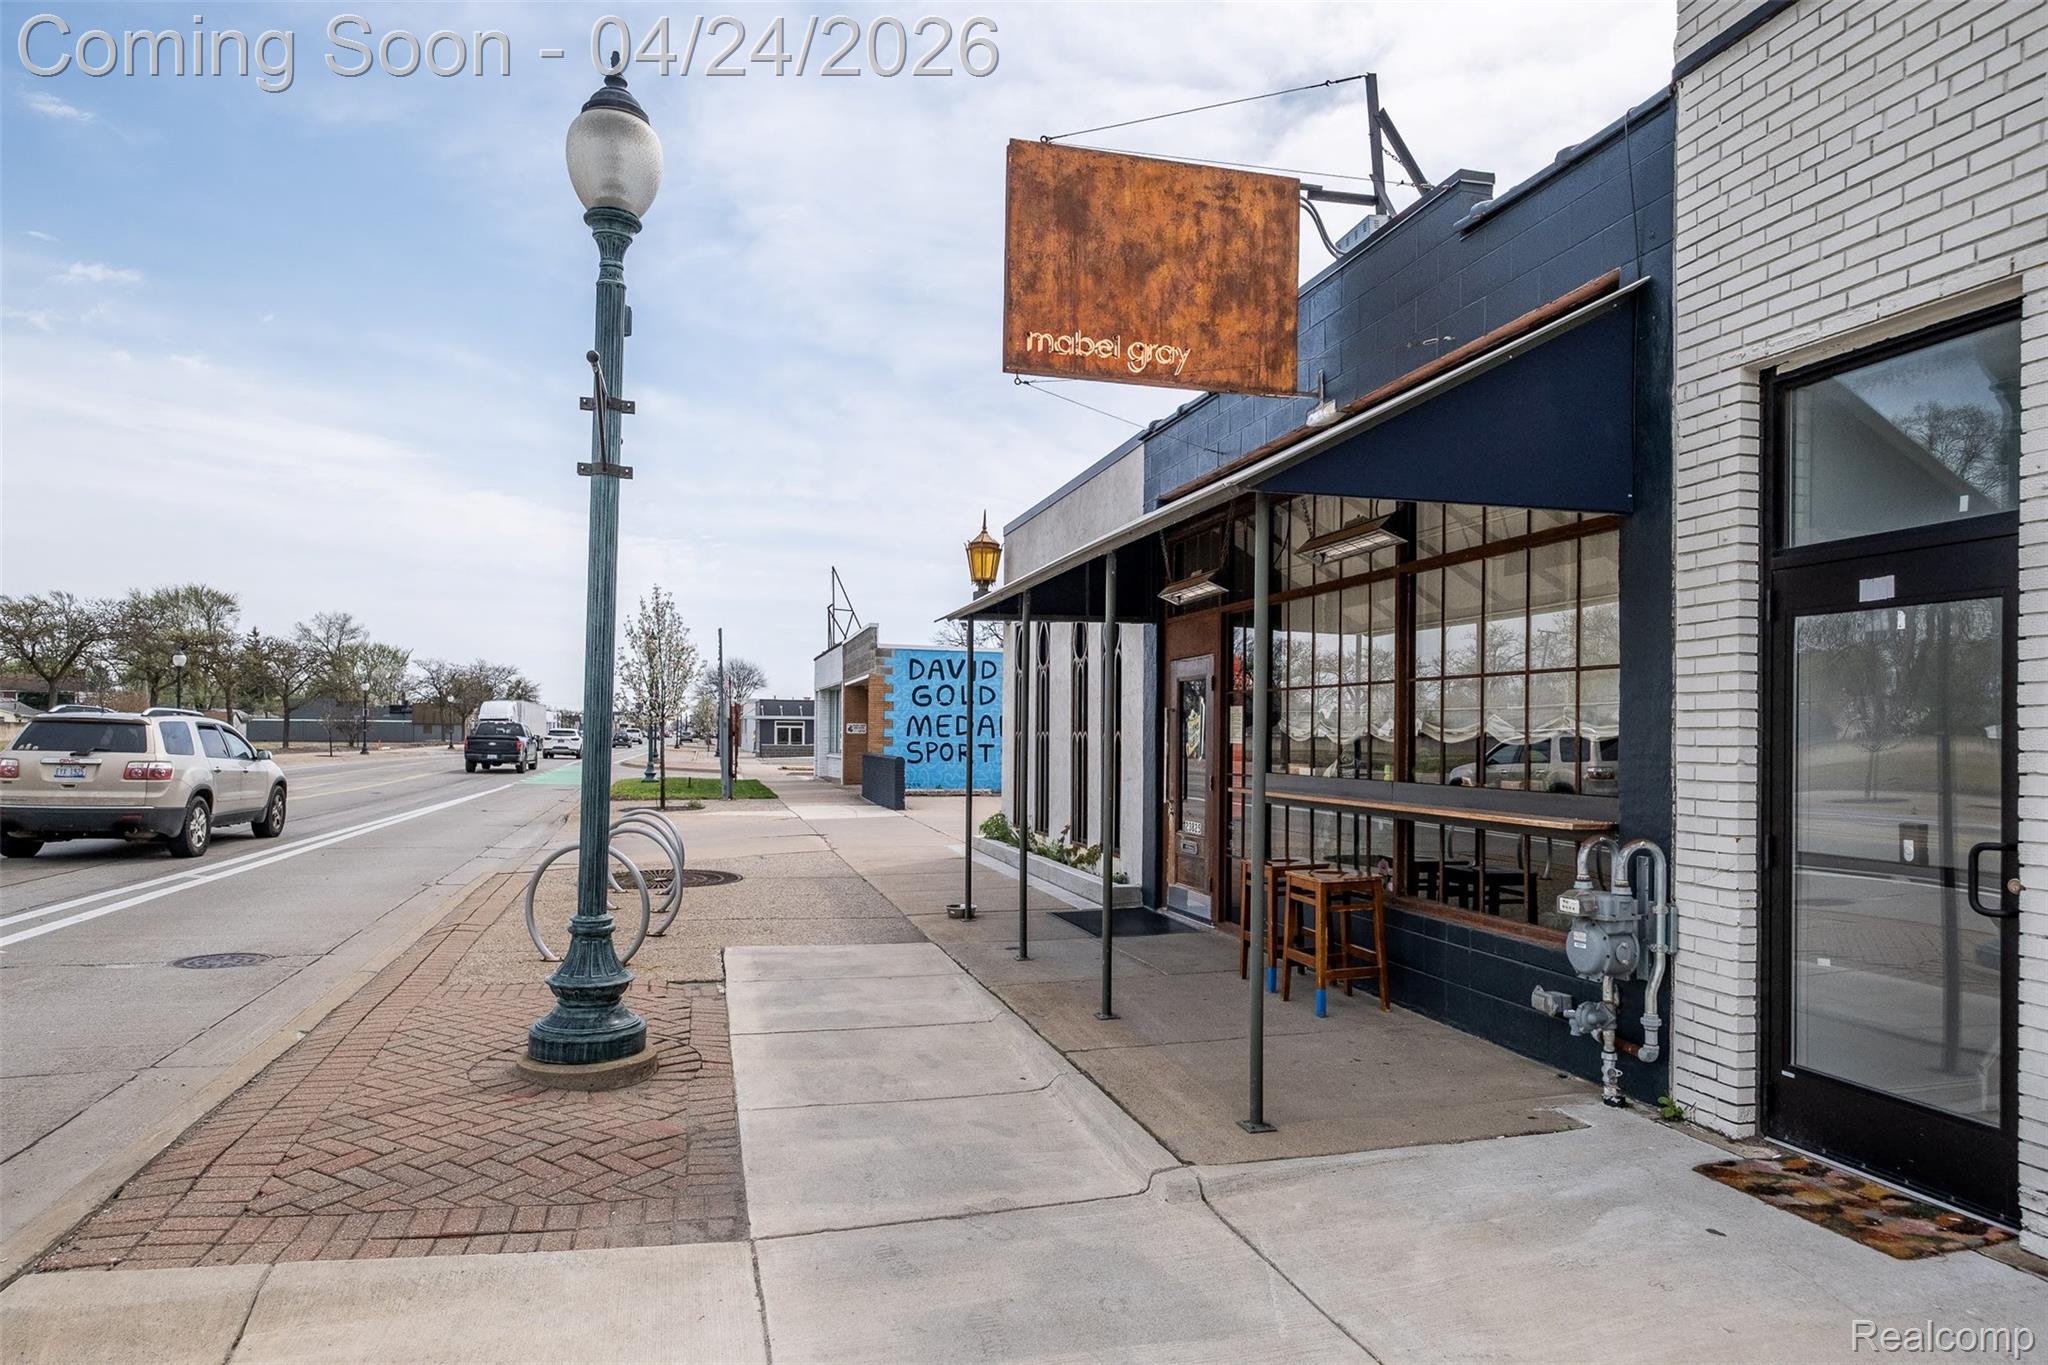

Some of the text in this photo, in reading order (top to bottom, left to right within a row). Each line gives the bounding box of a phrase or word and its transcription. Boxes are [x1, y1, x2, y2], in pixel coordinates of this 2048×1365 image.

[1026, 330, 1191, 376] mabel gray
[909, 658, 997, 681] DAVID
[911, 685, 997, 707] GOLD
